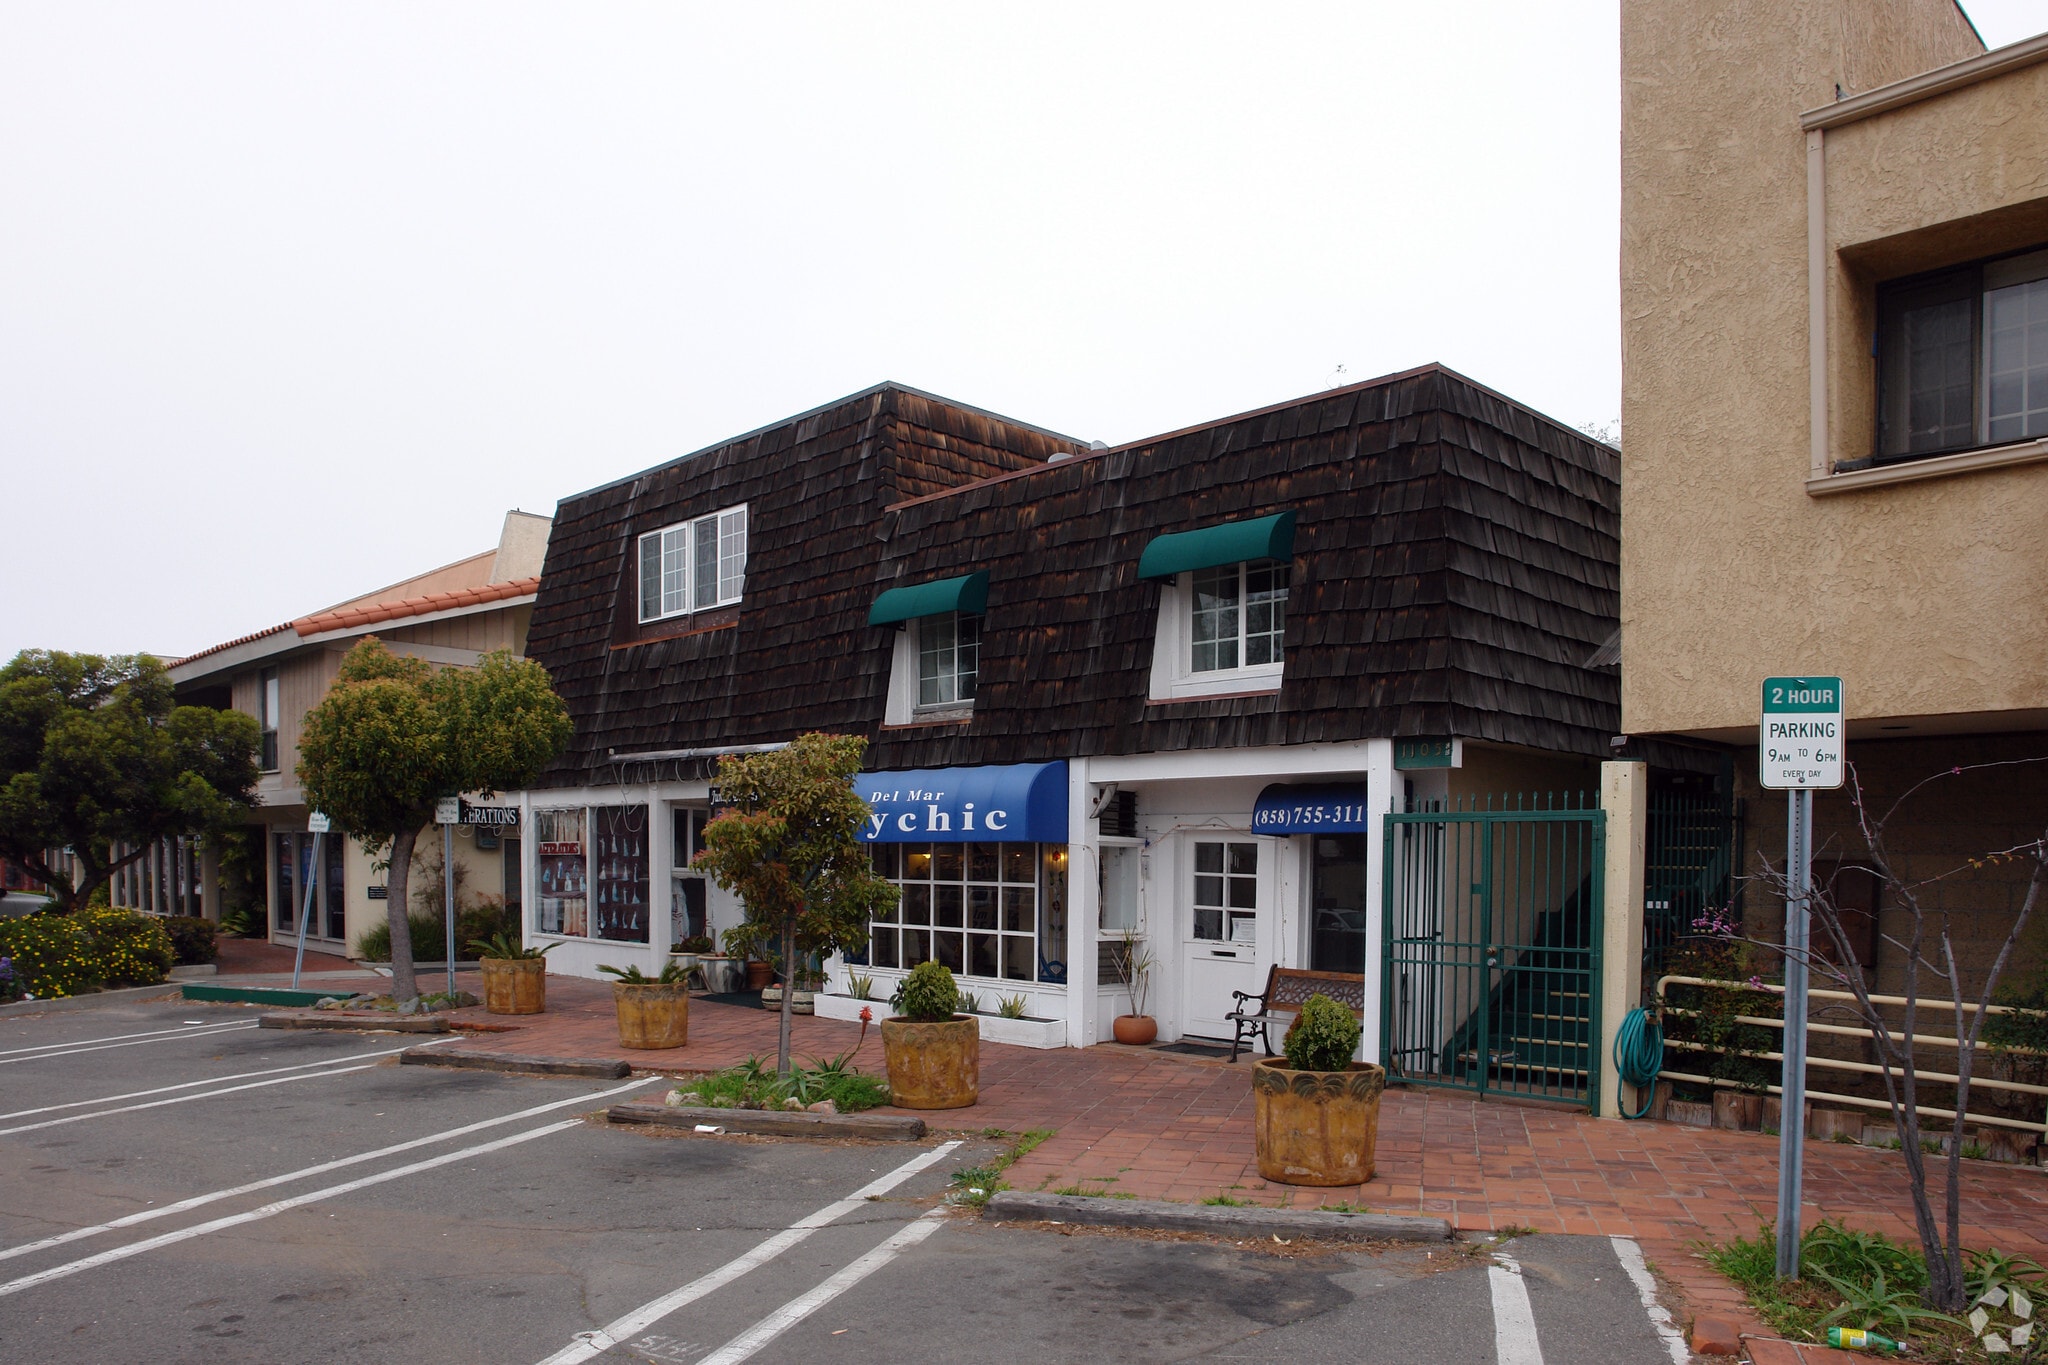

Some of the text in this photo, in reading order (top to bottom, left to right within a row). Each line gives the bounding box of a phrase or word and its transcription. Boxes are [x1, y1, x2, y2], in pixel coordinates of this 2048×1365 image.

[1772, 687, 1834, 704] 2 HOUR
[1770, 722, 1835, 738] PARKING
[1402, 742, 1442, 758] 1105
[1768, 748, 1837, 762] 9AM TO 6PM
[1783, 770, 1822, 778] EVERY DAY
[870, 789, 945, 803] Del Mar
[460, 808, 517, 825] ERATIONS
[866, 803, 1008, 840] ychic
[1293, 805, 1364, 824] 755-311
